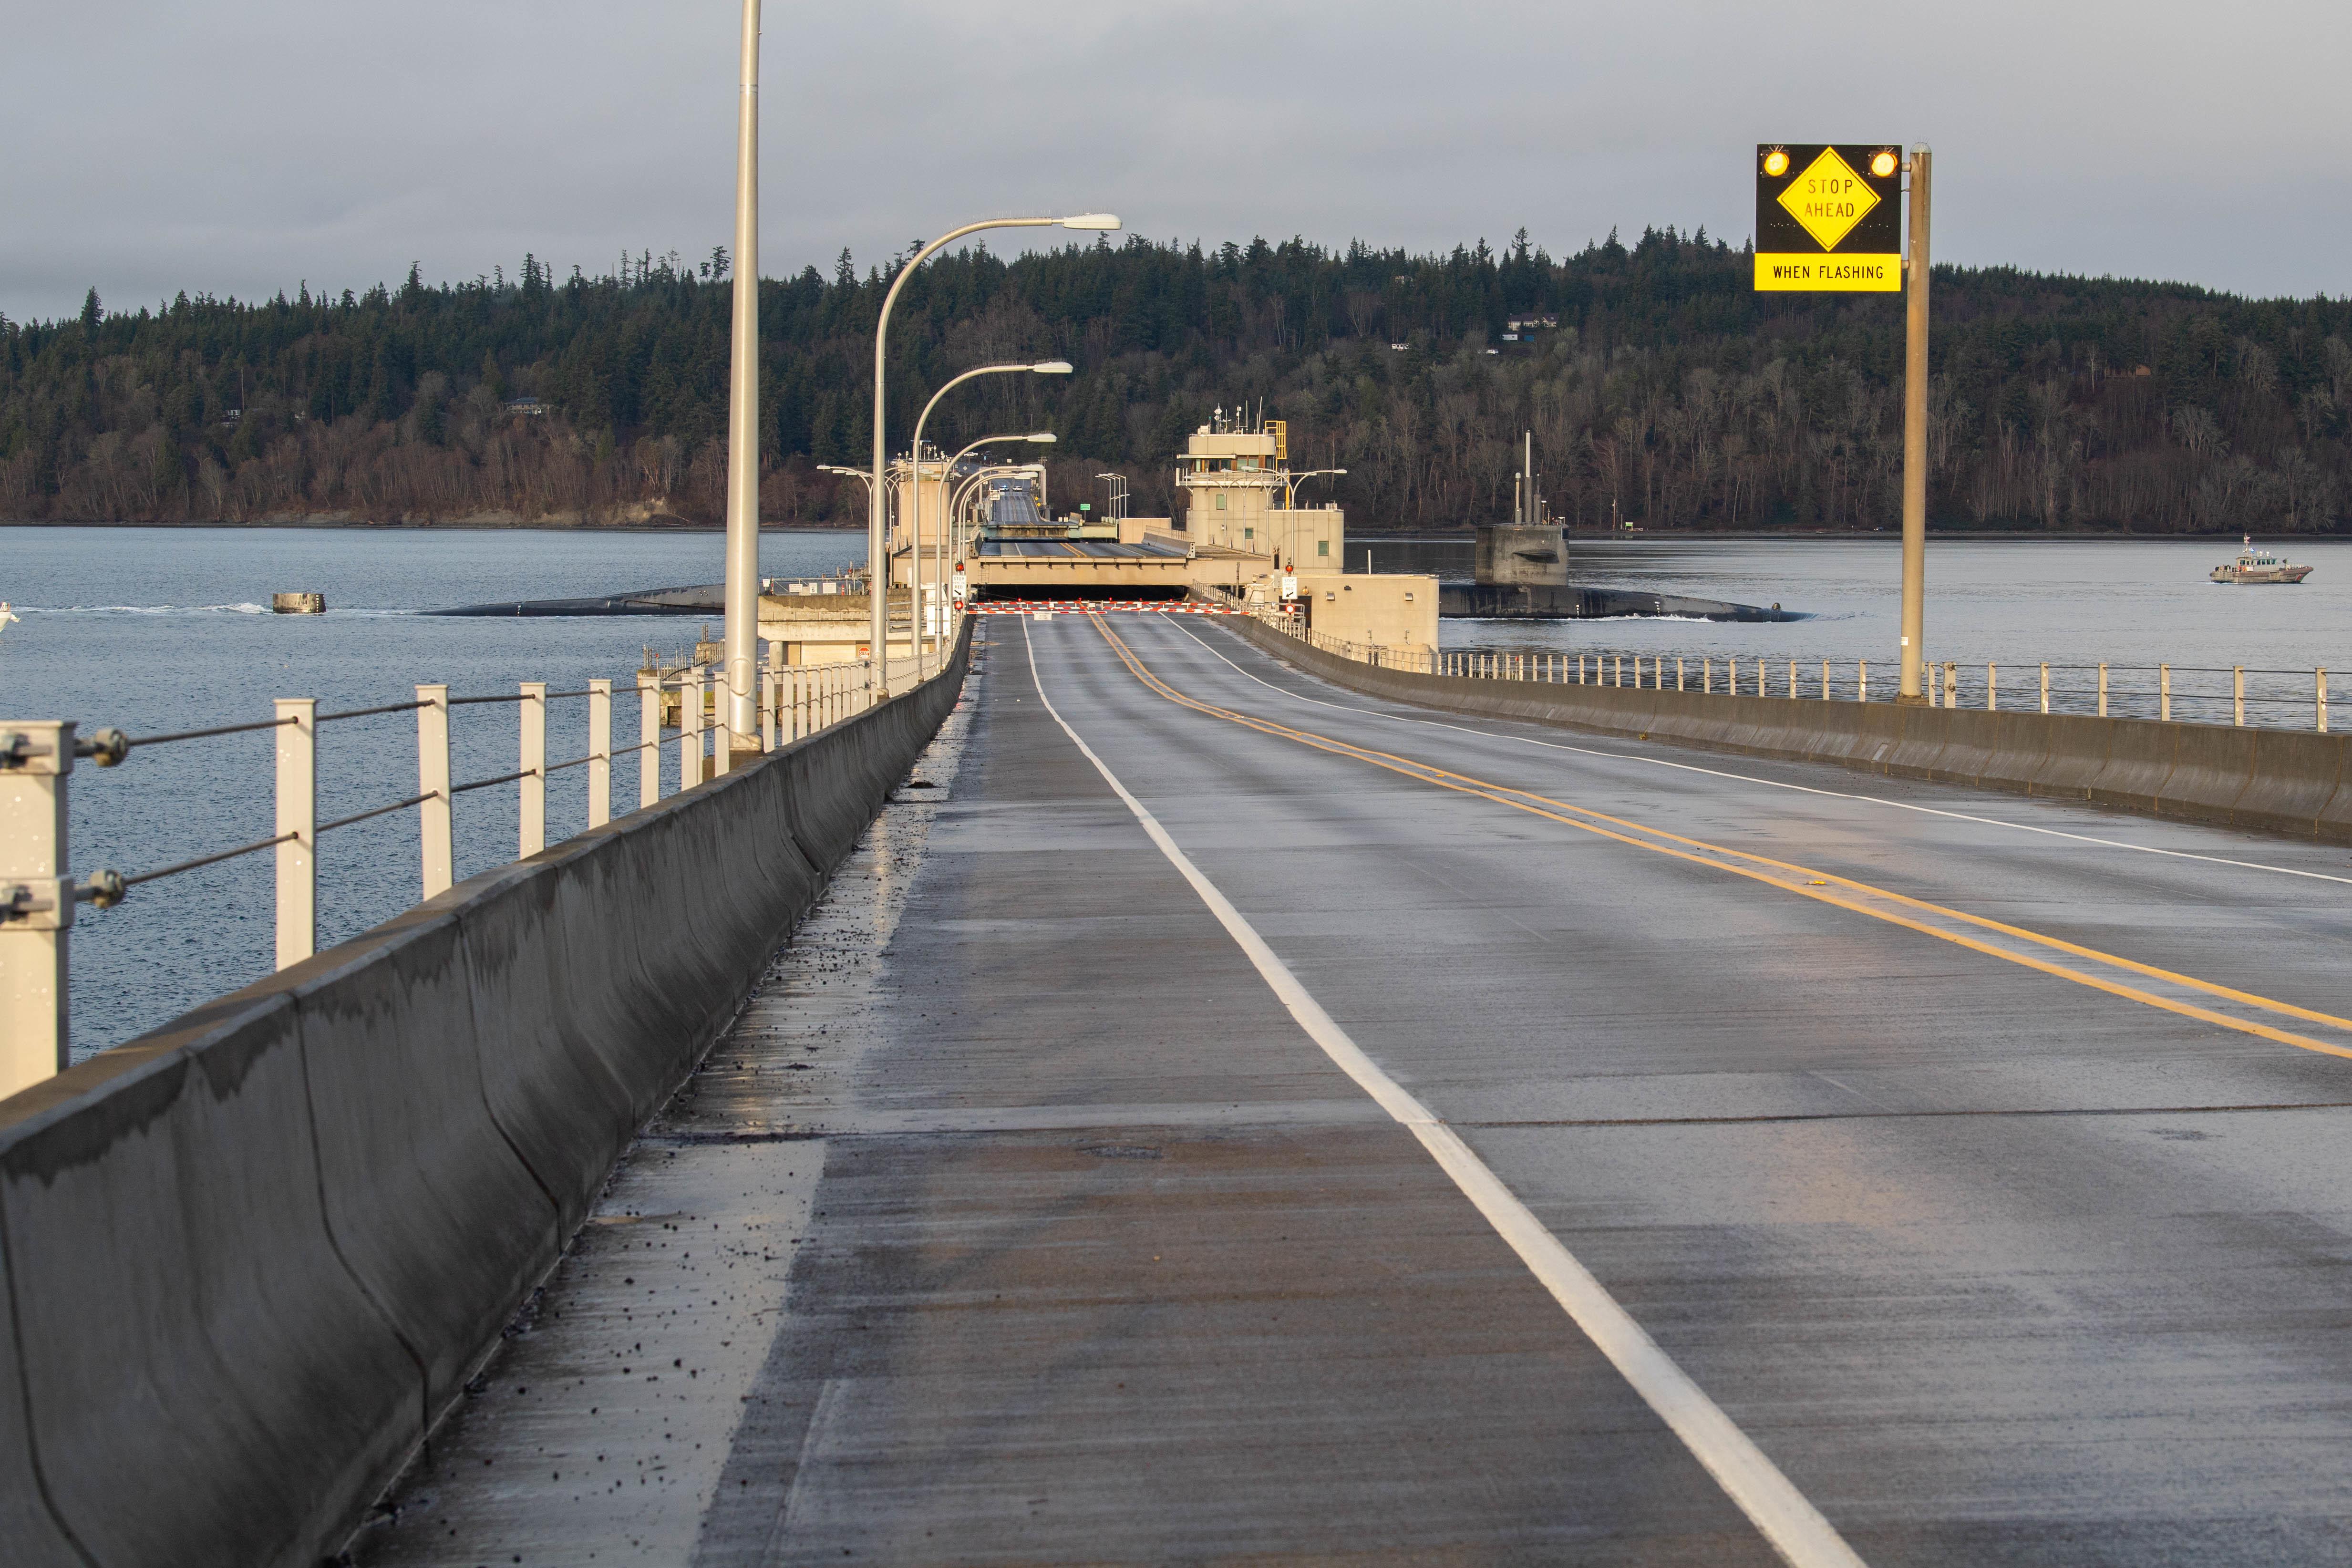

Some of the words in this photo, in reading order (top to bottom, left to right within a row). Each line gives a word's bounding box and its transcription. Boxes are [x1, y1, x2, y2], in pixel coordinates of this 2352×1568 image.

[1808, 179, 1853, 194] STOP
[1805, 202, 1854, 217] AHEAD
[1773, 266, 1810, 279] WHEN
[1819, 266, 1883, 279] FLASHING
